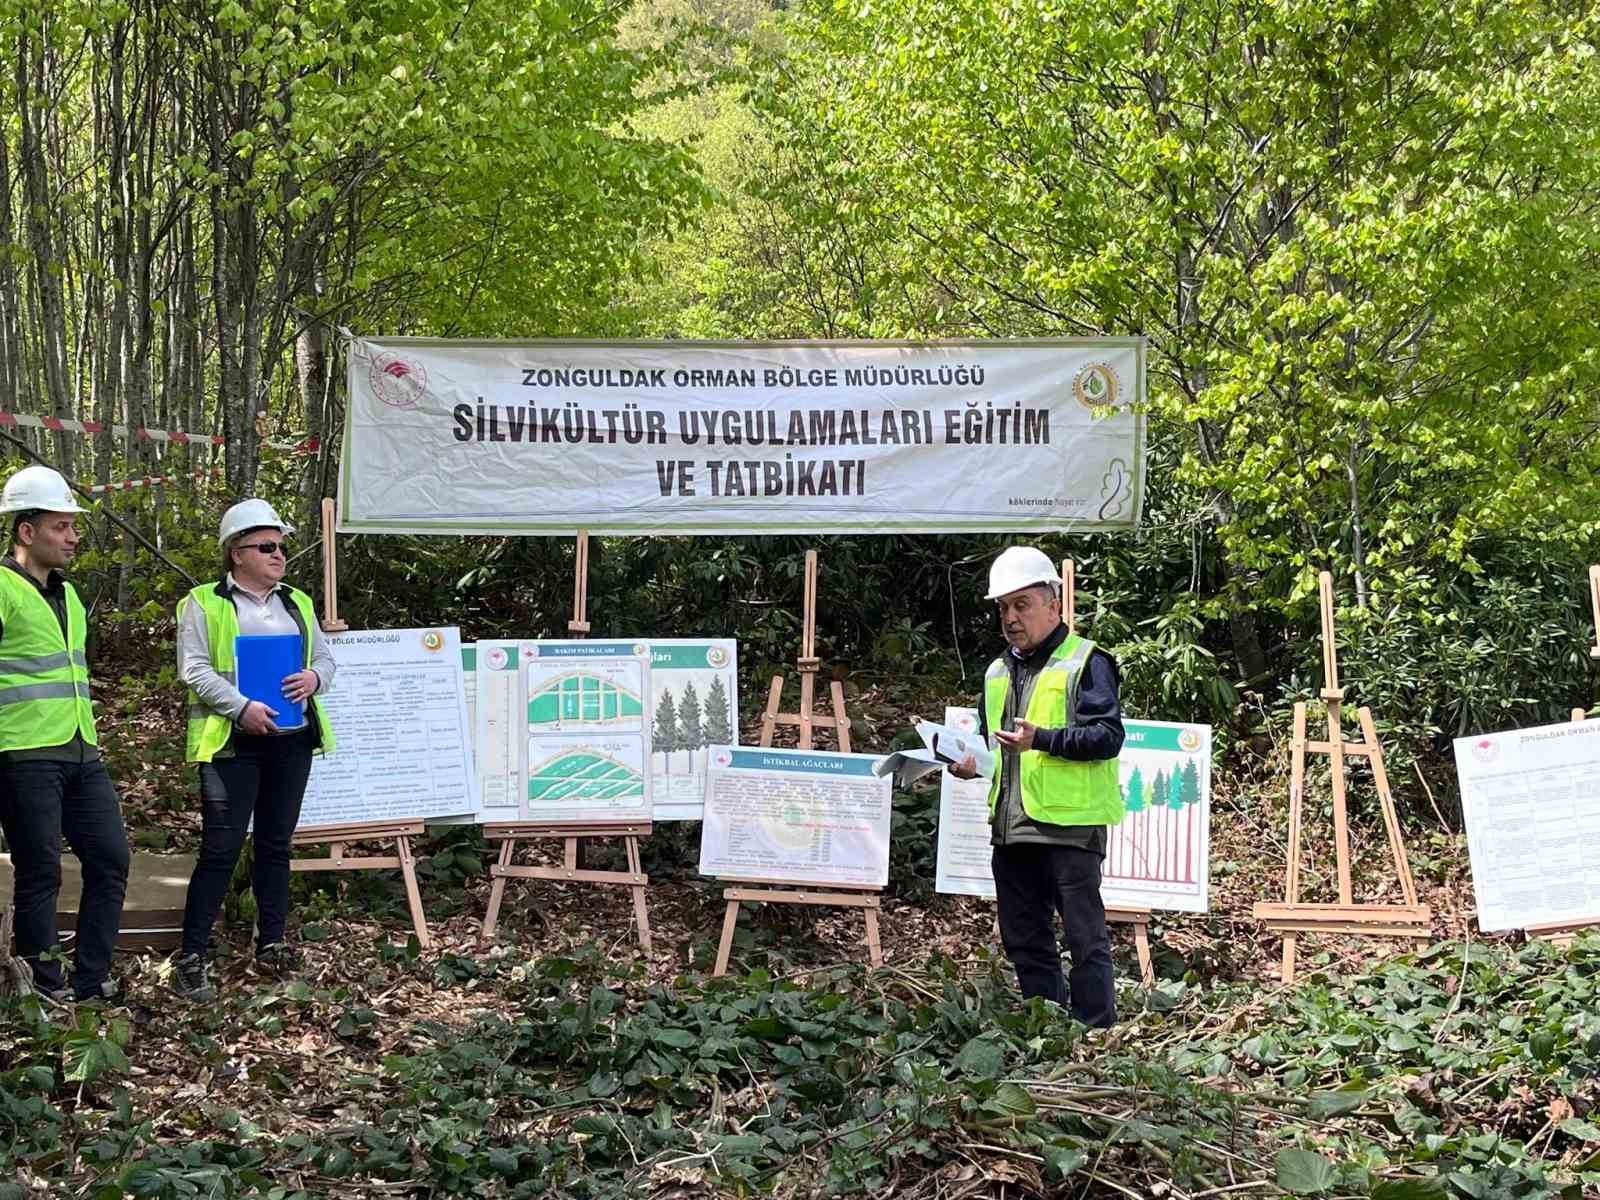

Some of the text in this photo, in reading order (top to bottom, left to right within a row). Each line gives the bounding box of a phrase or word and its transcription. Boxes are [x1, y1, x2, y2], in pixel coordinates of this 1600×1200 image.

[522, 365, 985, 387] ZONGULDAK ORMAN BÖLGE MÜDÜRLÜĞÜ
[453, 397, 1050, 446] SİLVİKÜLTÜR UYGULAMALARI EĞİTİM
[656, 453, 866, 497] VE TATBİKATI
[1008, 497, 1053, 506] köklerinde
